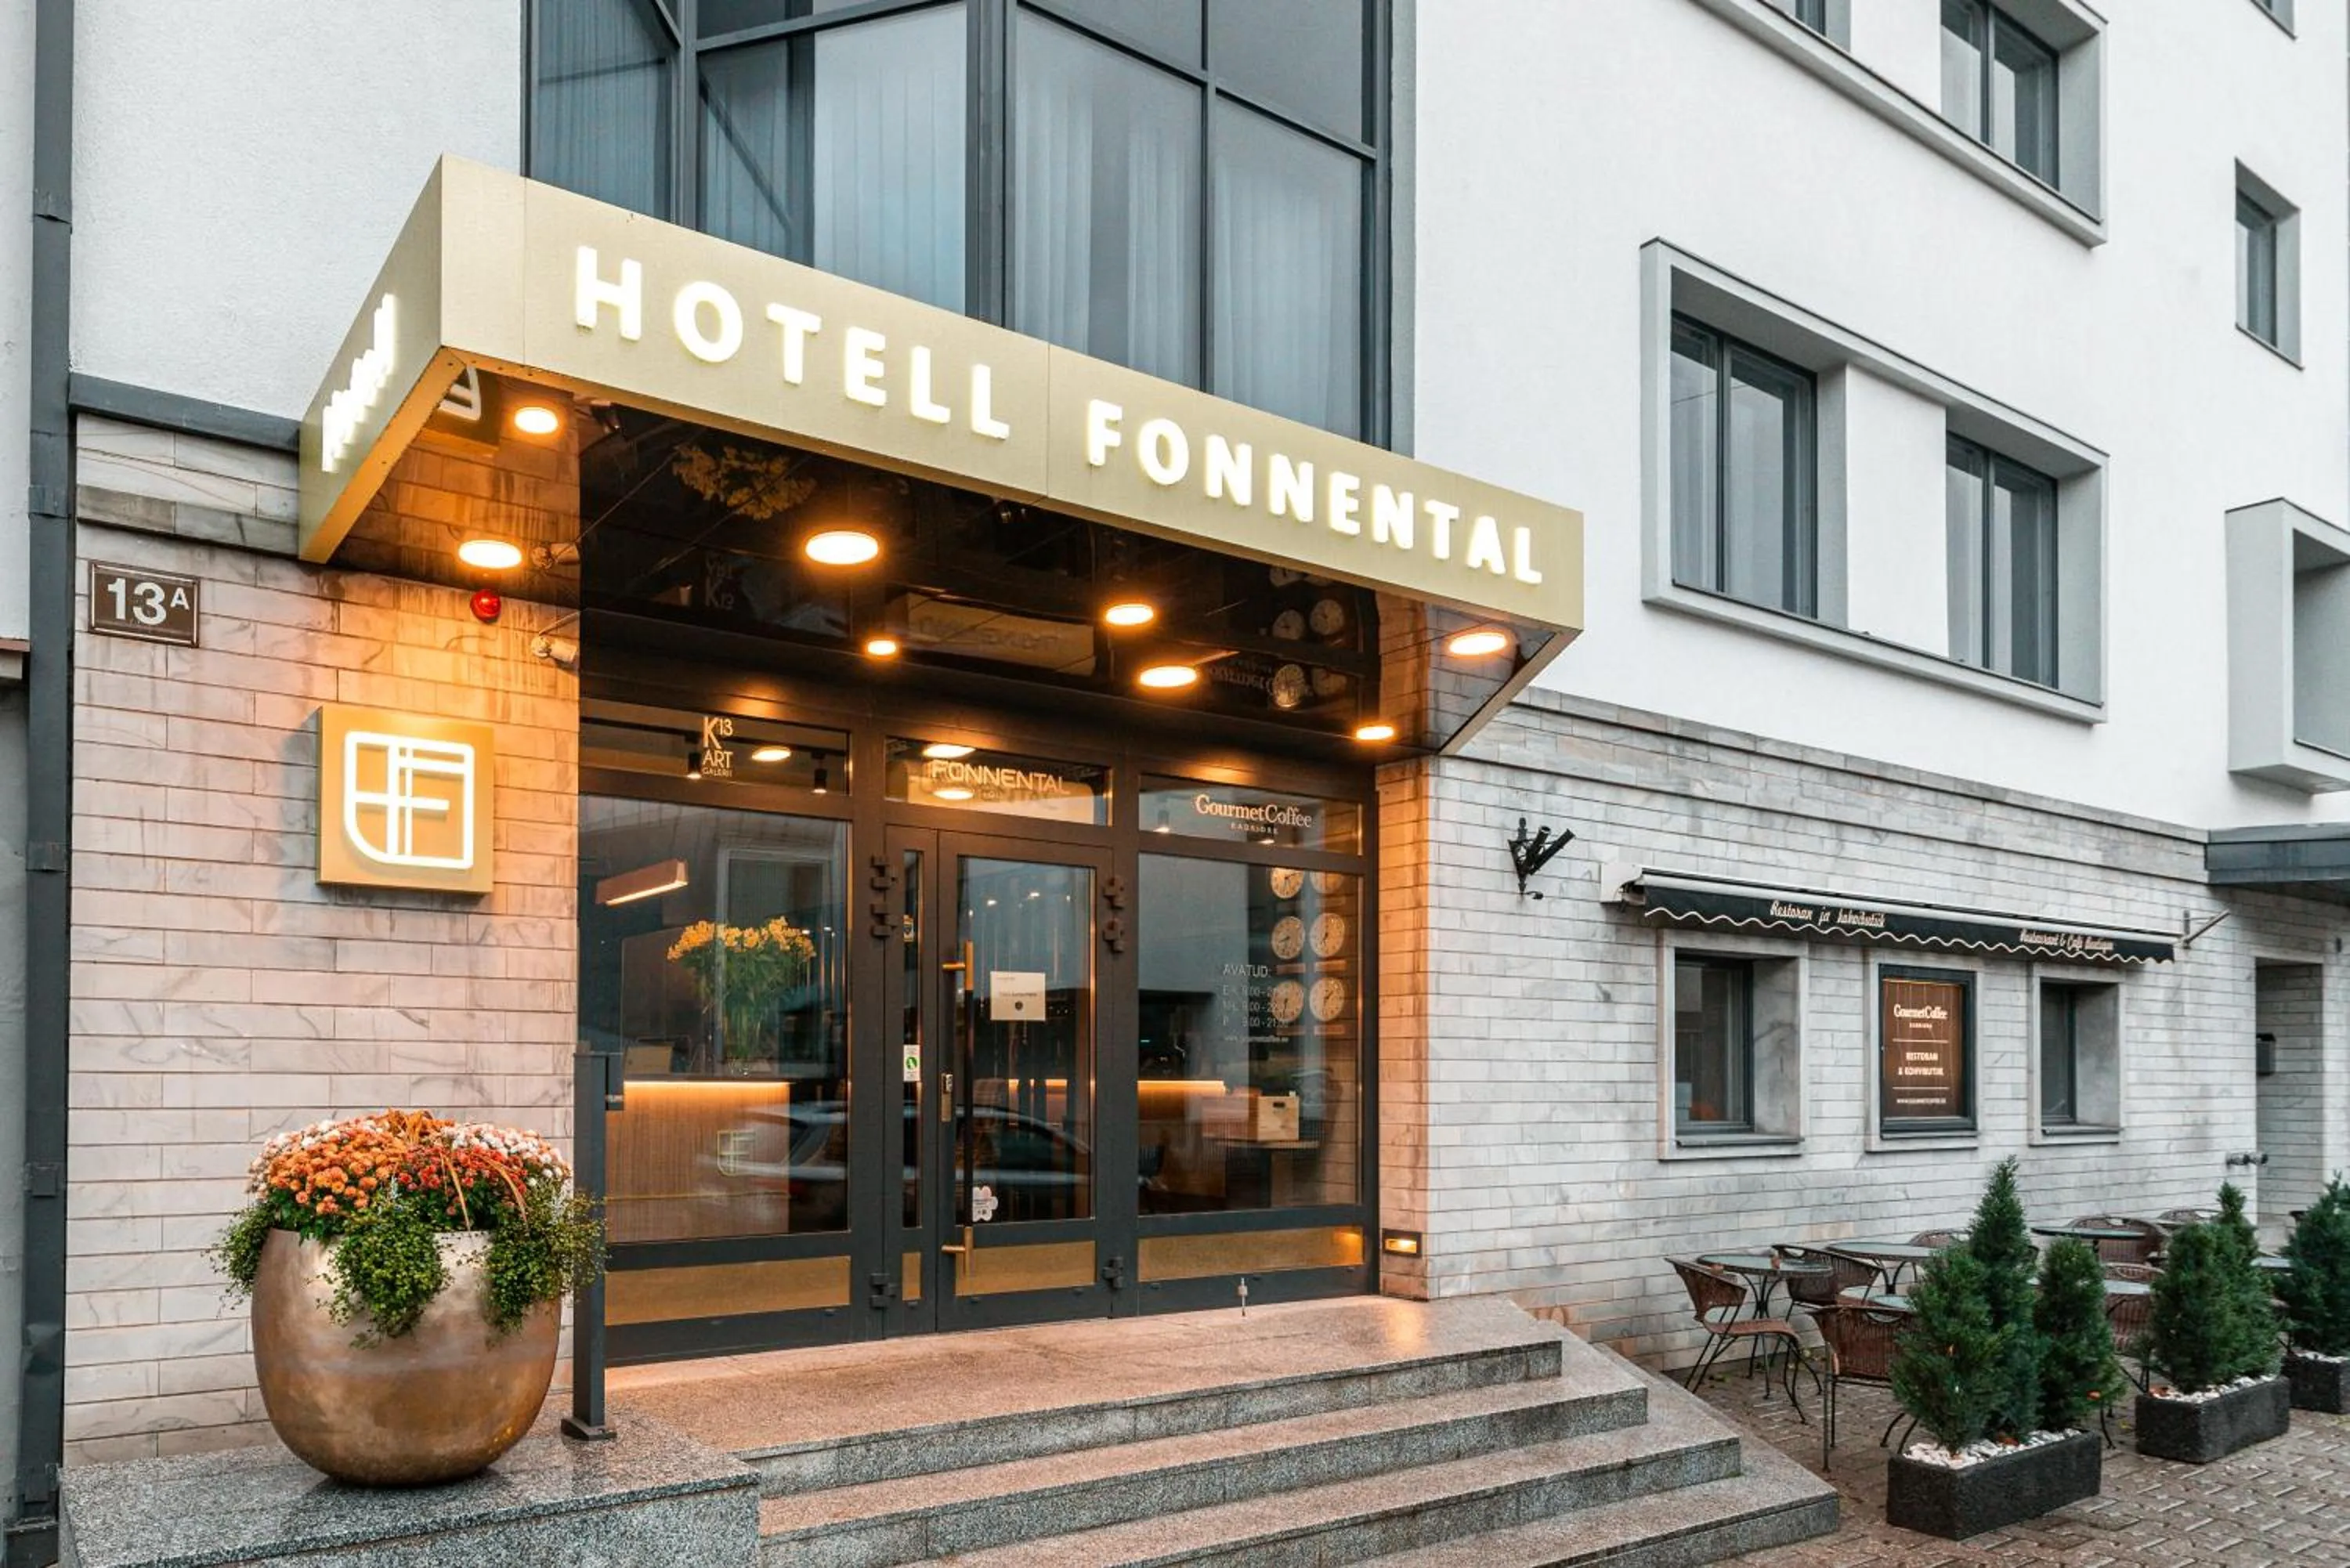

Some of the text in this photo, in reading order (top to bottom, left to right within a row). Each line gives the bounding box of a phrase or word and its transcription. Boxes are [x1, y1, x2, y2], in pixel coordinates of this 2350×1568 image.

[575, 244, 1010, 441] HOTELL
[1086, 397, 1543, 586] FONNENTAL
[703, 749, 734, 768] ART
[931, 759, 1072, 795] FONNENTAL
[1195, 793, 1313, 828] GourmetCoffee
